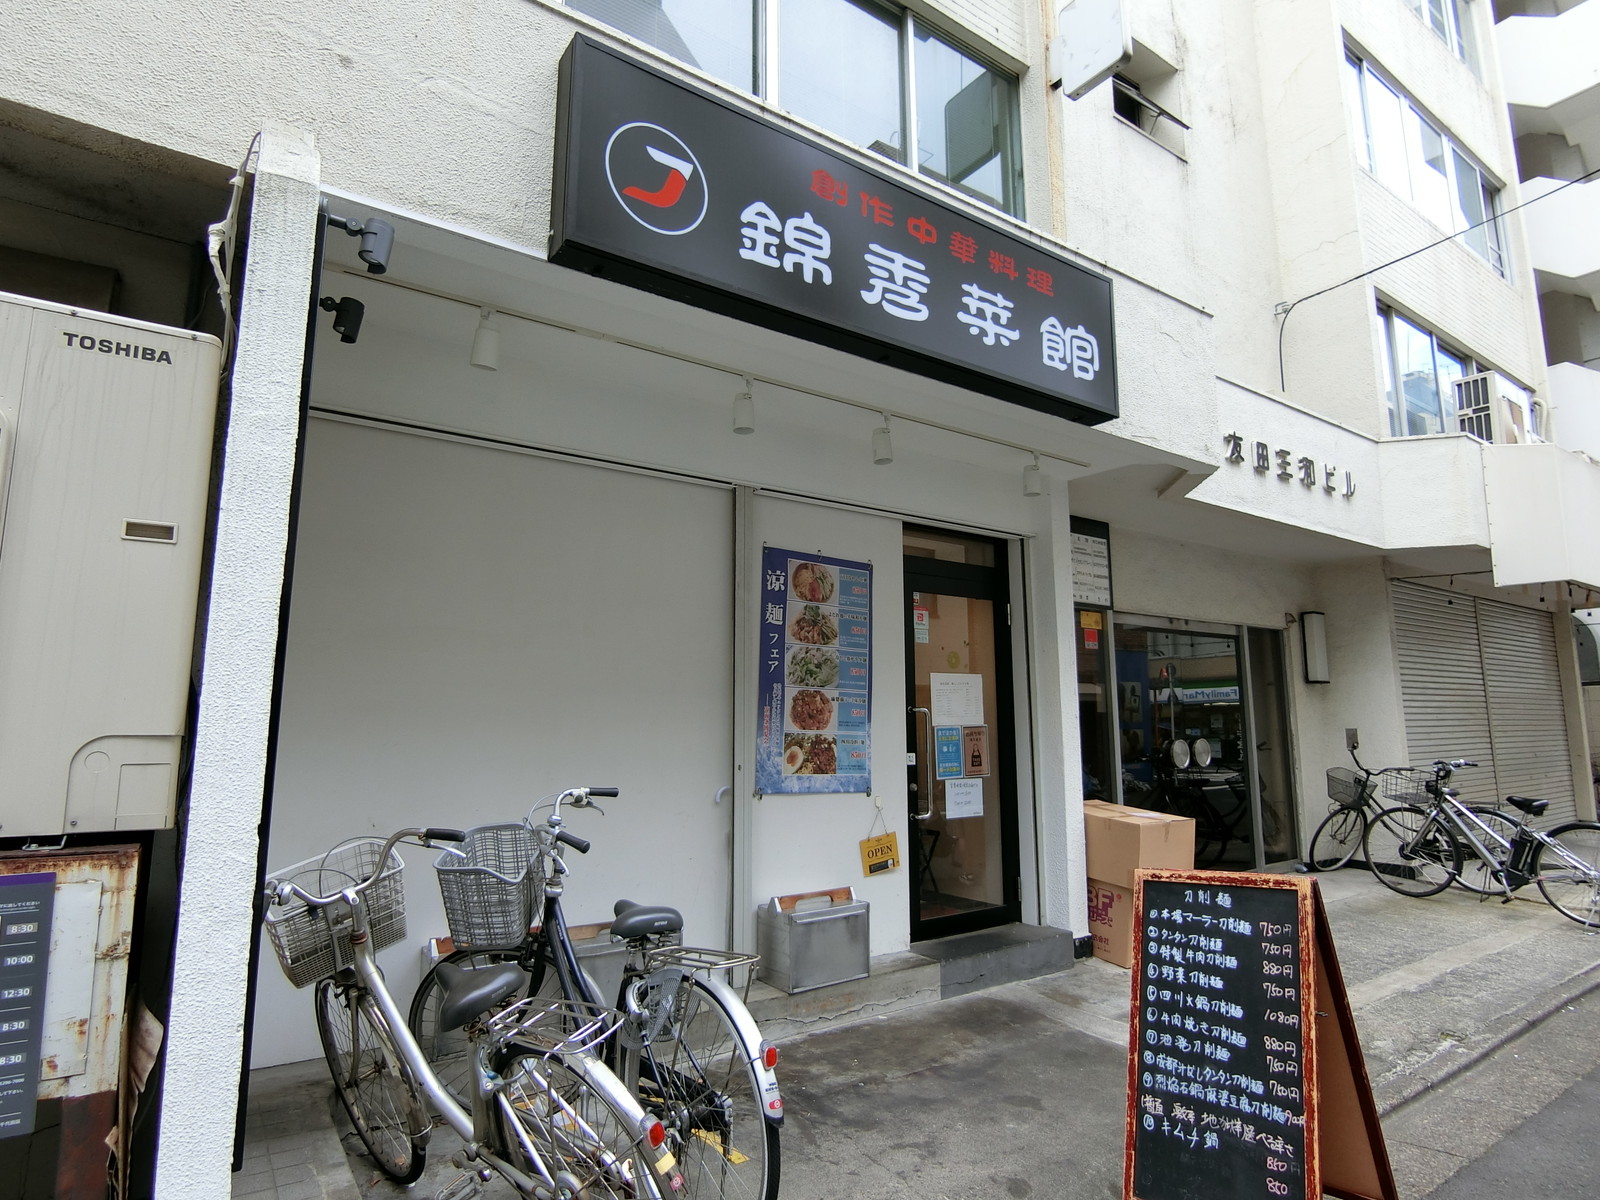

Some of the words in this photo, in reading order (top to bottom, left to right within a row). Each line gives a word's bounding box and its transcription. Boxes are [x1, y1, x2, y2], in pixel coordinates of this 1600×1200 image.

[810, 169, 1055, 298] 創作中華料理
[739, 201, 1101, 381] 錦秀菜館
[63, 332, 172, 365] TOSHIBA
[867, 844, 893, 859] OPEN
[1184, 890, 1232, 907] 刀削麺
[11, 924, 33, 933] 8:30
[1262, 942, 1292, 958] 750円
[6, 955, 33, 966] 10:00
[1262, 960, 1293, 979] 880円
[4, 988, 30, 998] 12:30
[2, 1021, 25, 1031] 8:30
[1264, 1008, 1299, 1029] 1080円
[1264, 1035, 1296, 1057] 880円
